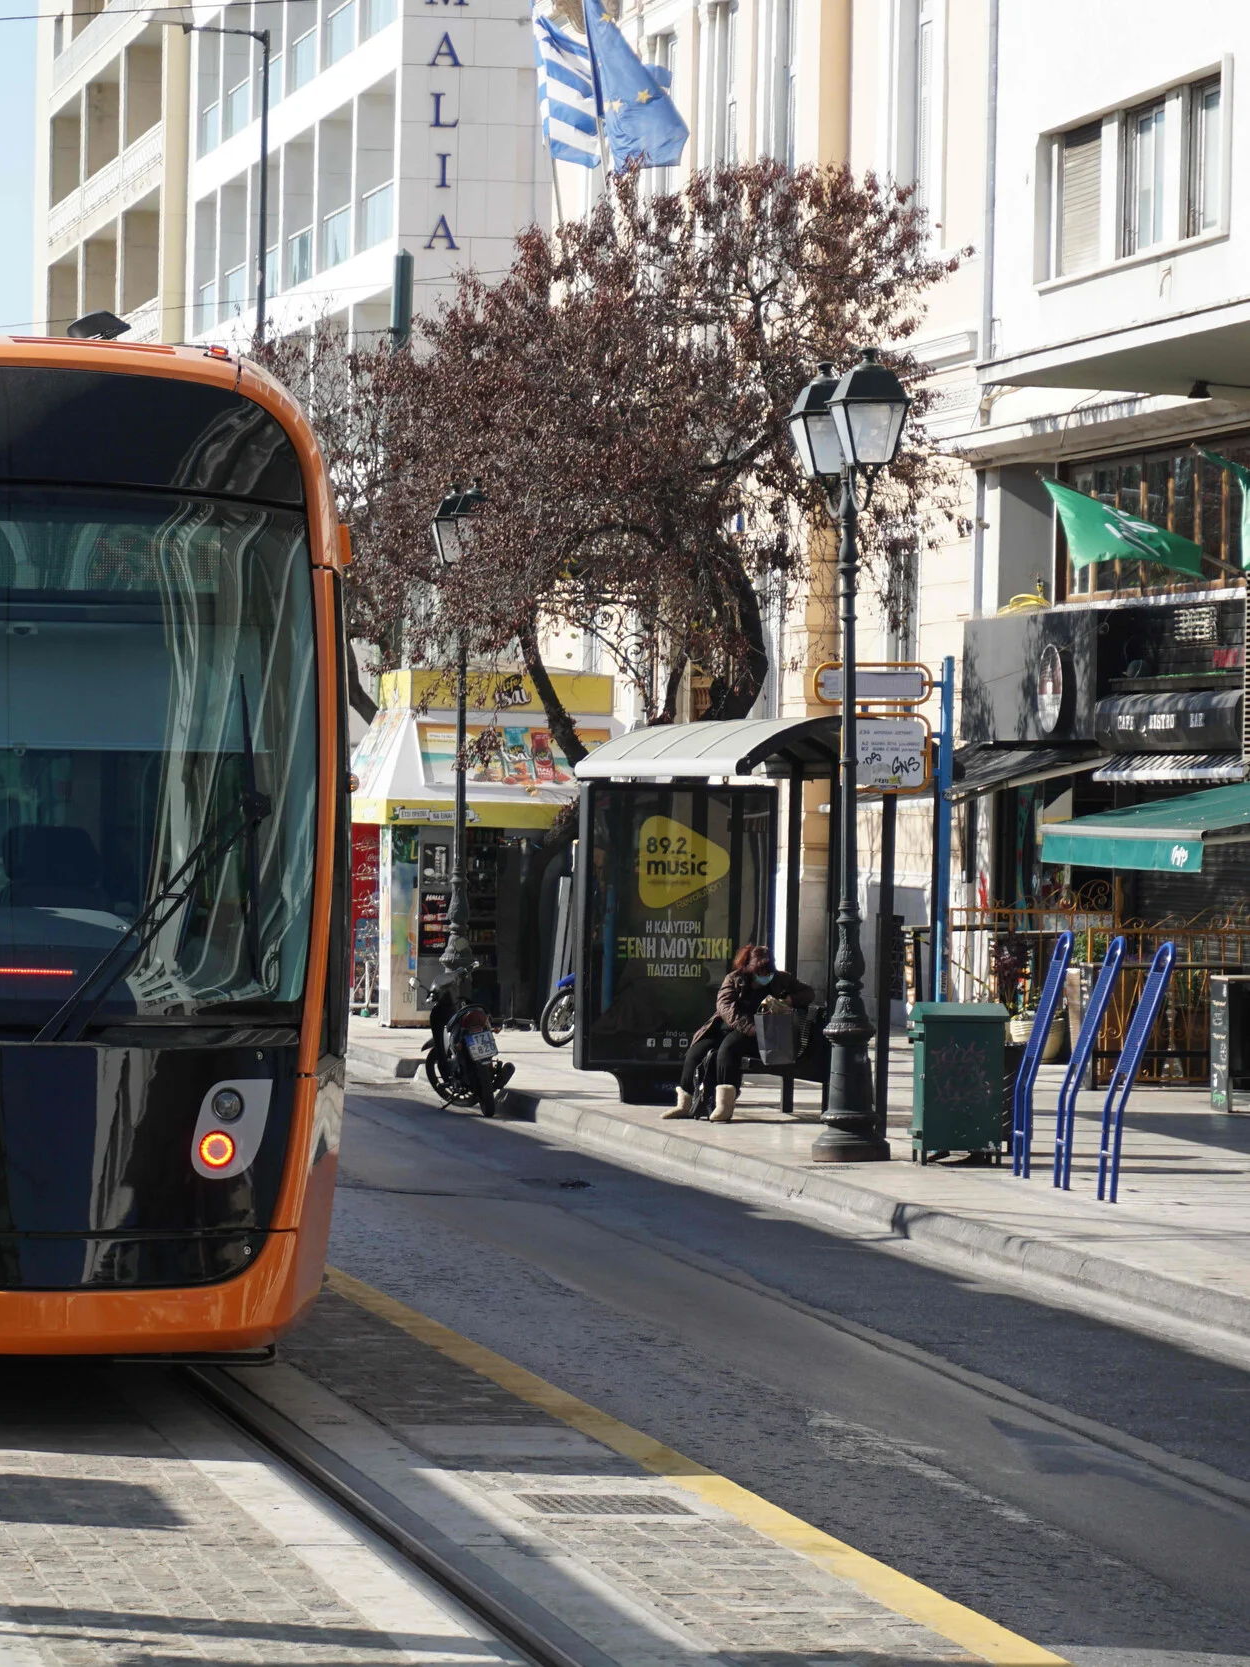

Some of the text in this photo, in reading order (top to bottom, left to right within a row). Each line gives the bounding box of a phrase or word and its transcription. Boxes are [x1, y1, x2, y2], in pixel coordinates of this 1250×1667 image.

[423, 0, 469, 250] ALIA
[646, 836, 687, 854] 89.2
[646, 853, 708, 876] music
[425, 894, 445, 902] HALLS
[675, 881, 722, 909] Revolution
[646, 920, 701, 934] Η ΚΑΛΥΤΕΡΗ
[617, 937, 732, 960] ΞΕΝΗ ΜΟΥΣΙΚΗ
[647, 963, 701, 978] ΠΑΙΖΕΙ ΕΔΩ!
